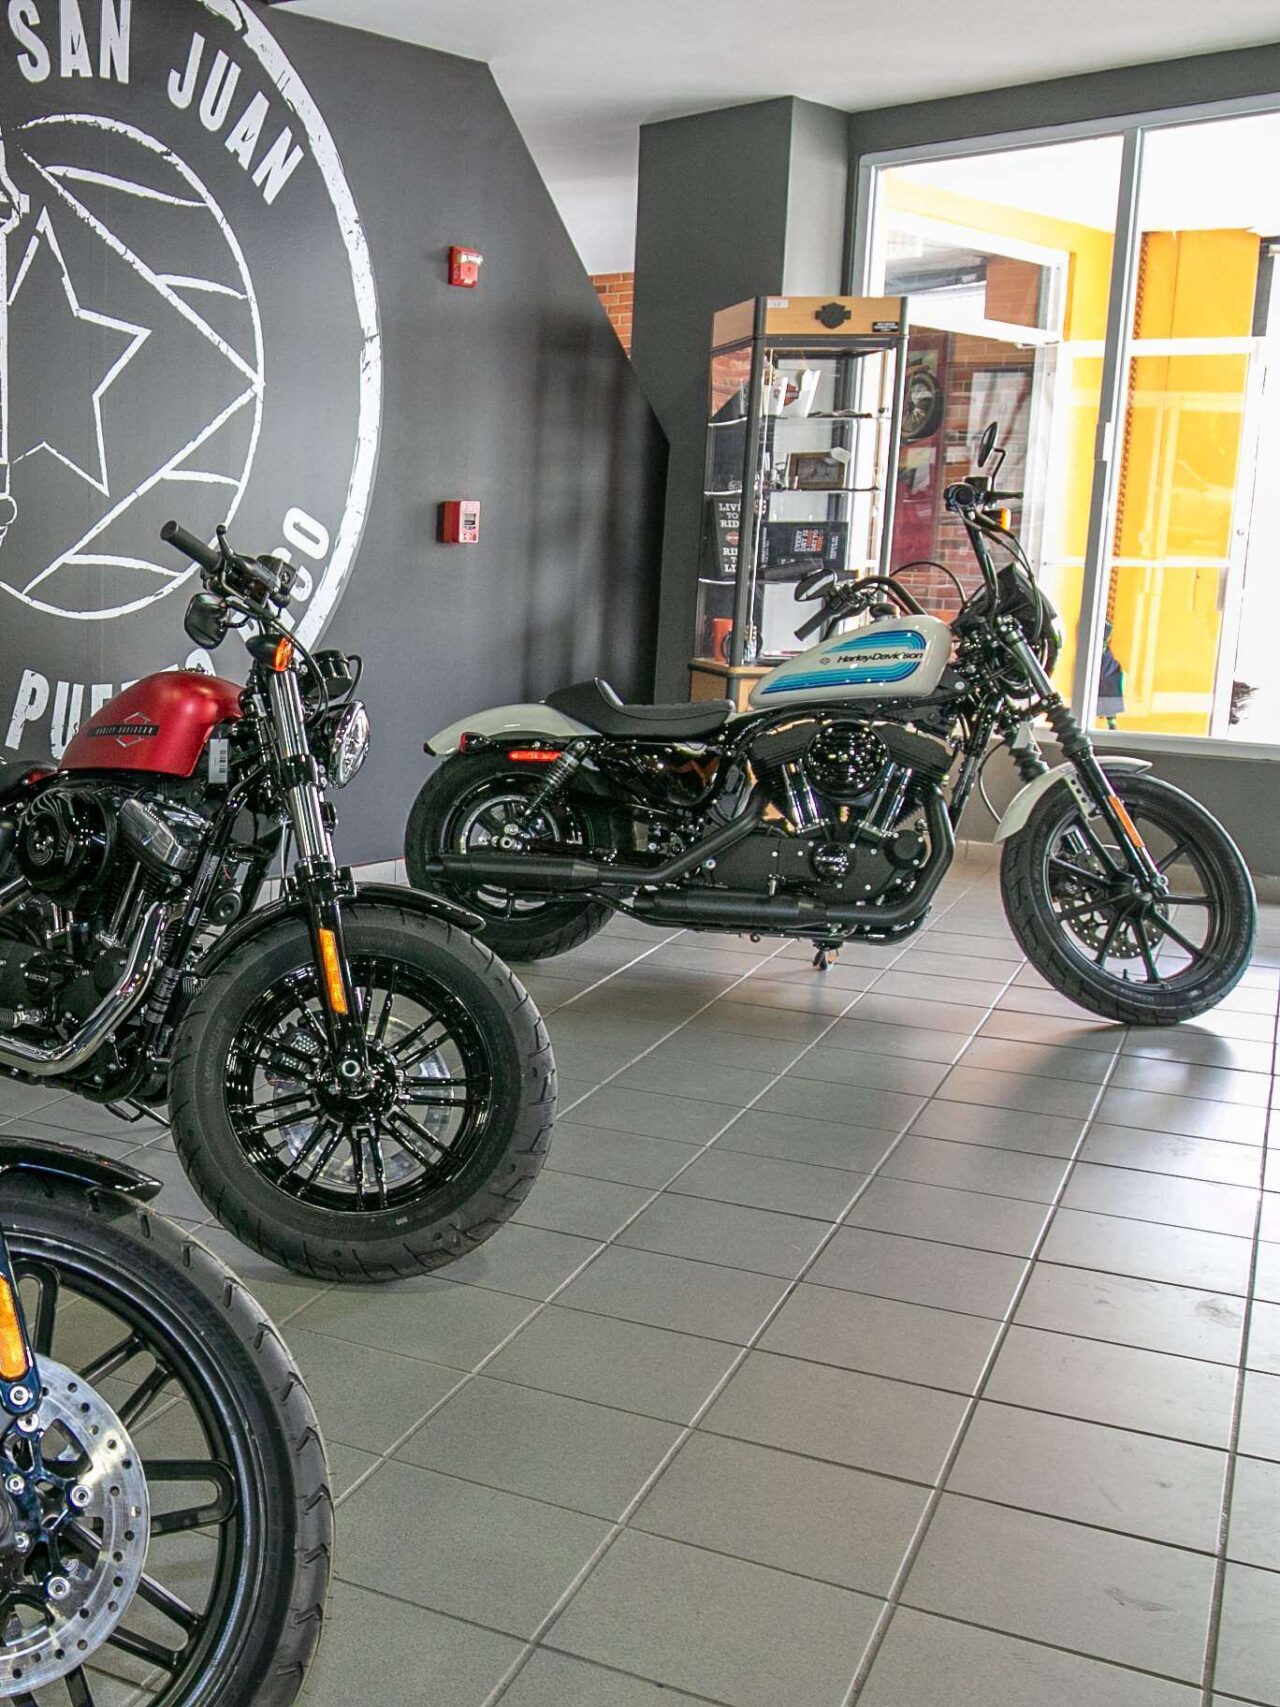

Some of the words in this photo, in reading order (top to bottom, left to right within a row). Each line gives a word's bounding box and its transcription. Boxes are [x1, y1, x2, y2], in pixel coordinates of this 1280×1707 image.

[8, 0, 131, 84] SAN
[167, 32, 305, 206] JUAN
[719, 503, 741, 511] LIV
[720, 520, 740, 528] RID
